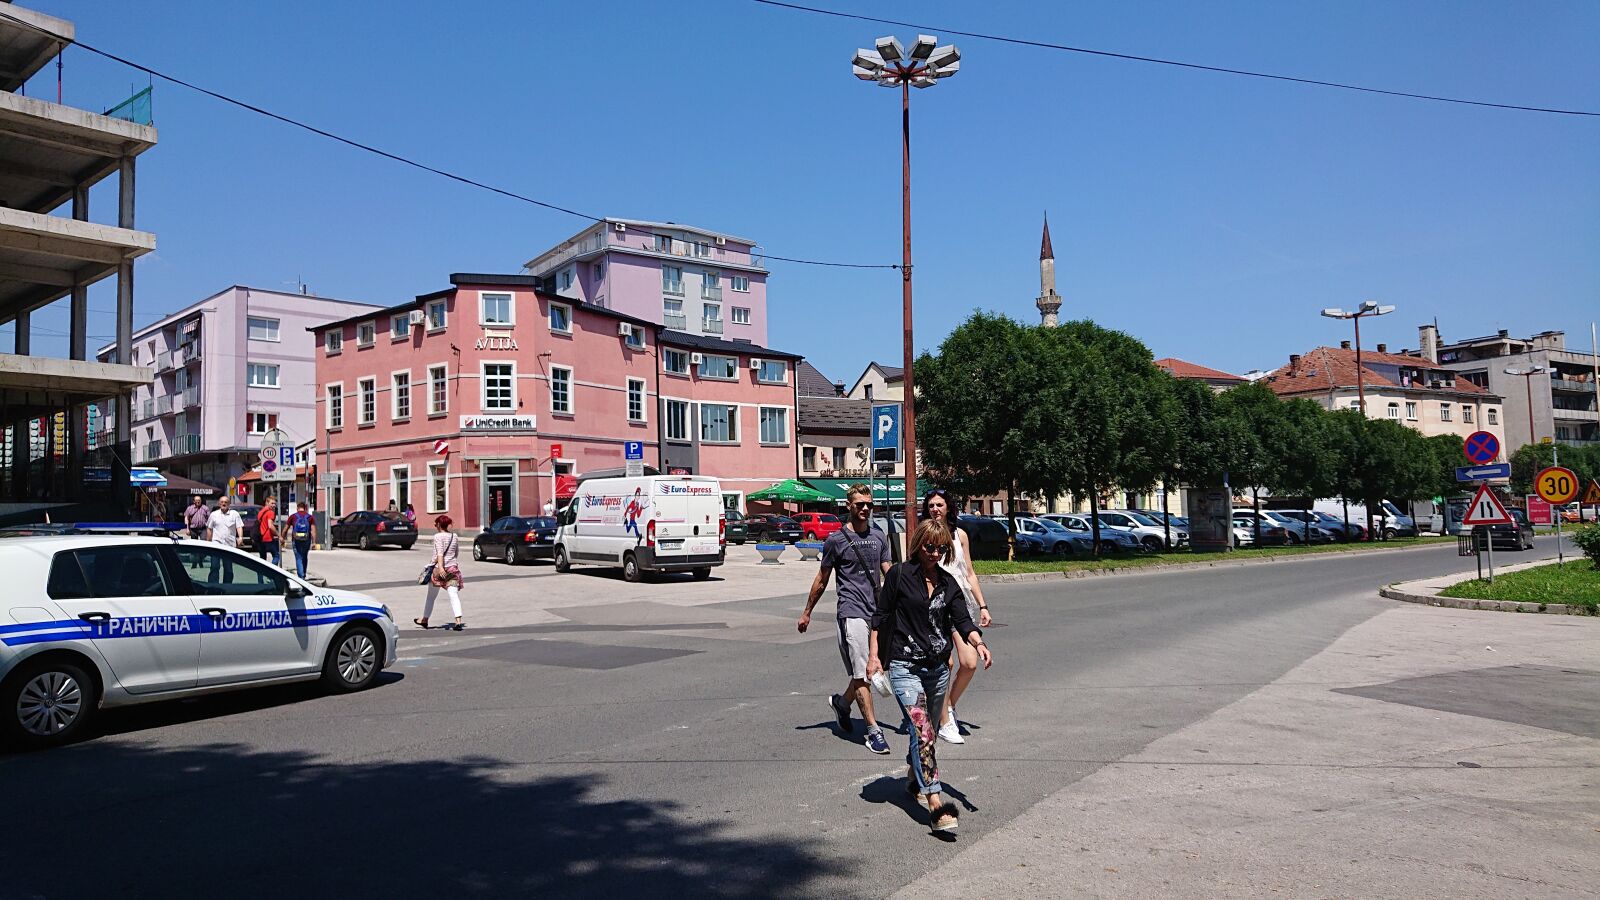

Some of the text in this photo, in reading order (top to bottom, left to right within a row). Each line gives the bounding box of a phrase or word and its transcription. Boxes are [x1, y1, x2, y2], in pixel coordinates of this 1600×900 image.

[475, 338, 518, 350] AVLIJA
[475, 418, 531, 427] UniCredit Bank
[878, 414, 894, 441] P
[630, 443, 638, 453] P
[671, 485, 712, 496] EuroExpress
[1545, 476, 1570, 496] 30
[592, 495, 622, 511] EuroExpress
[315, 594, 337, 606] 302
[213, 610, 292, 630] ПОЛИЦИЈА
